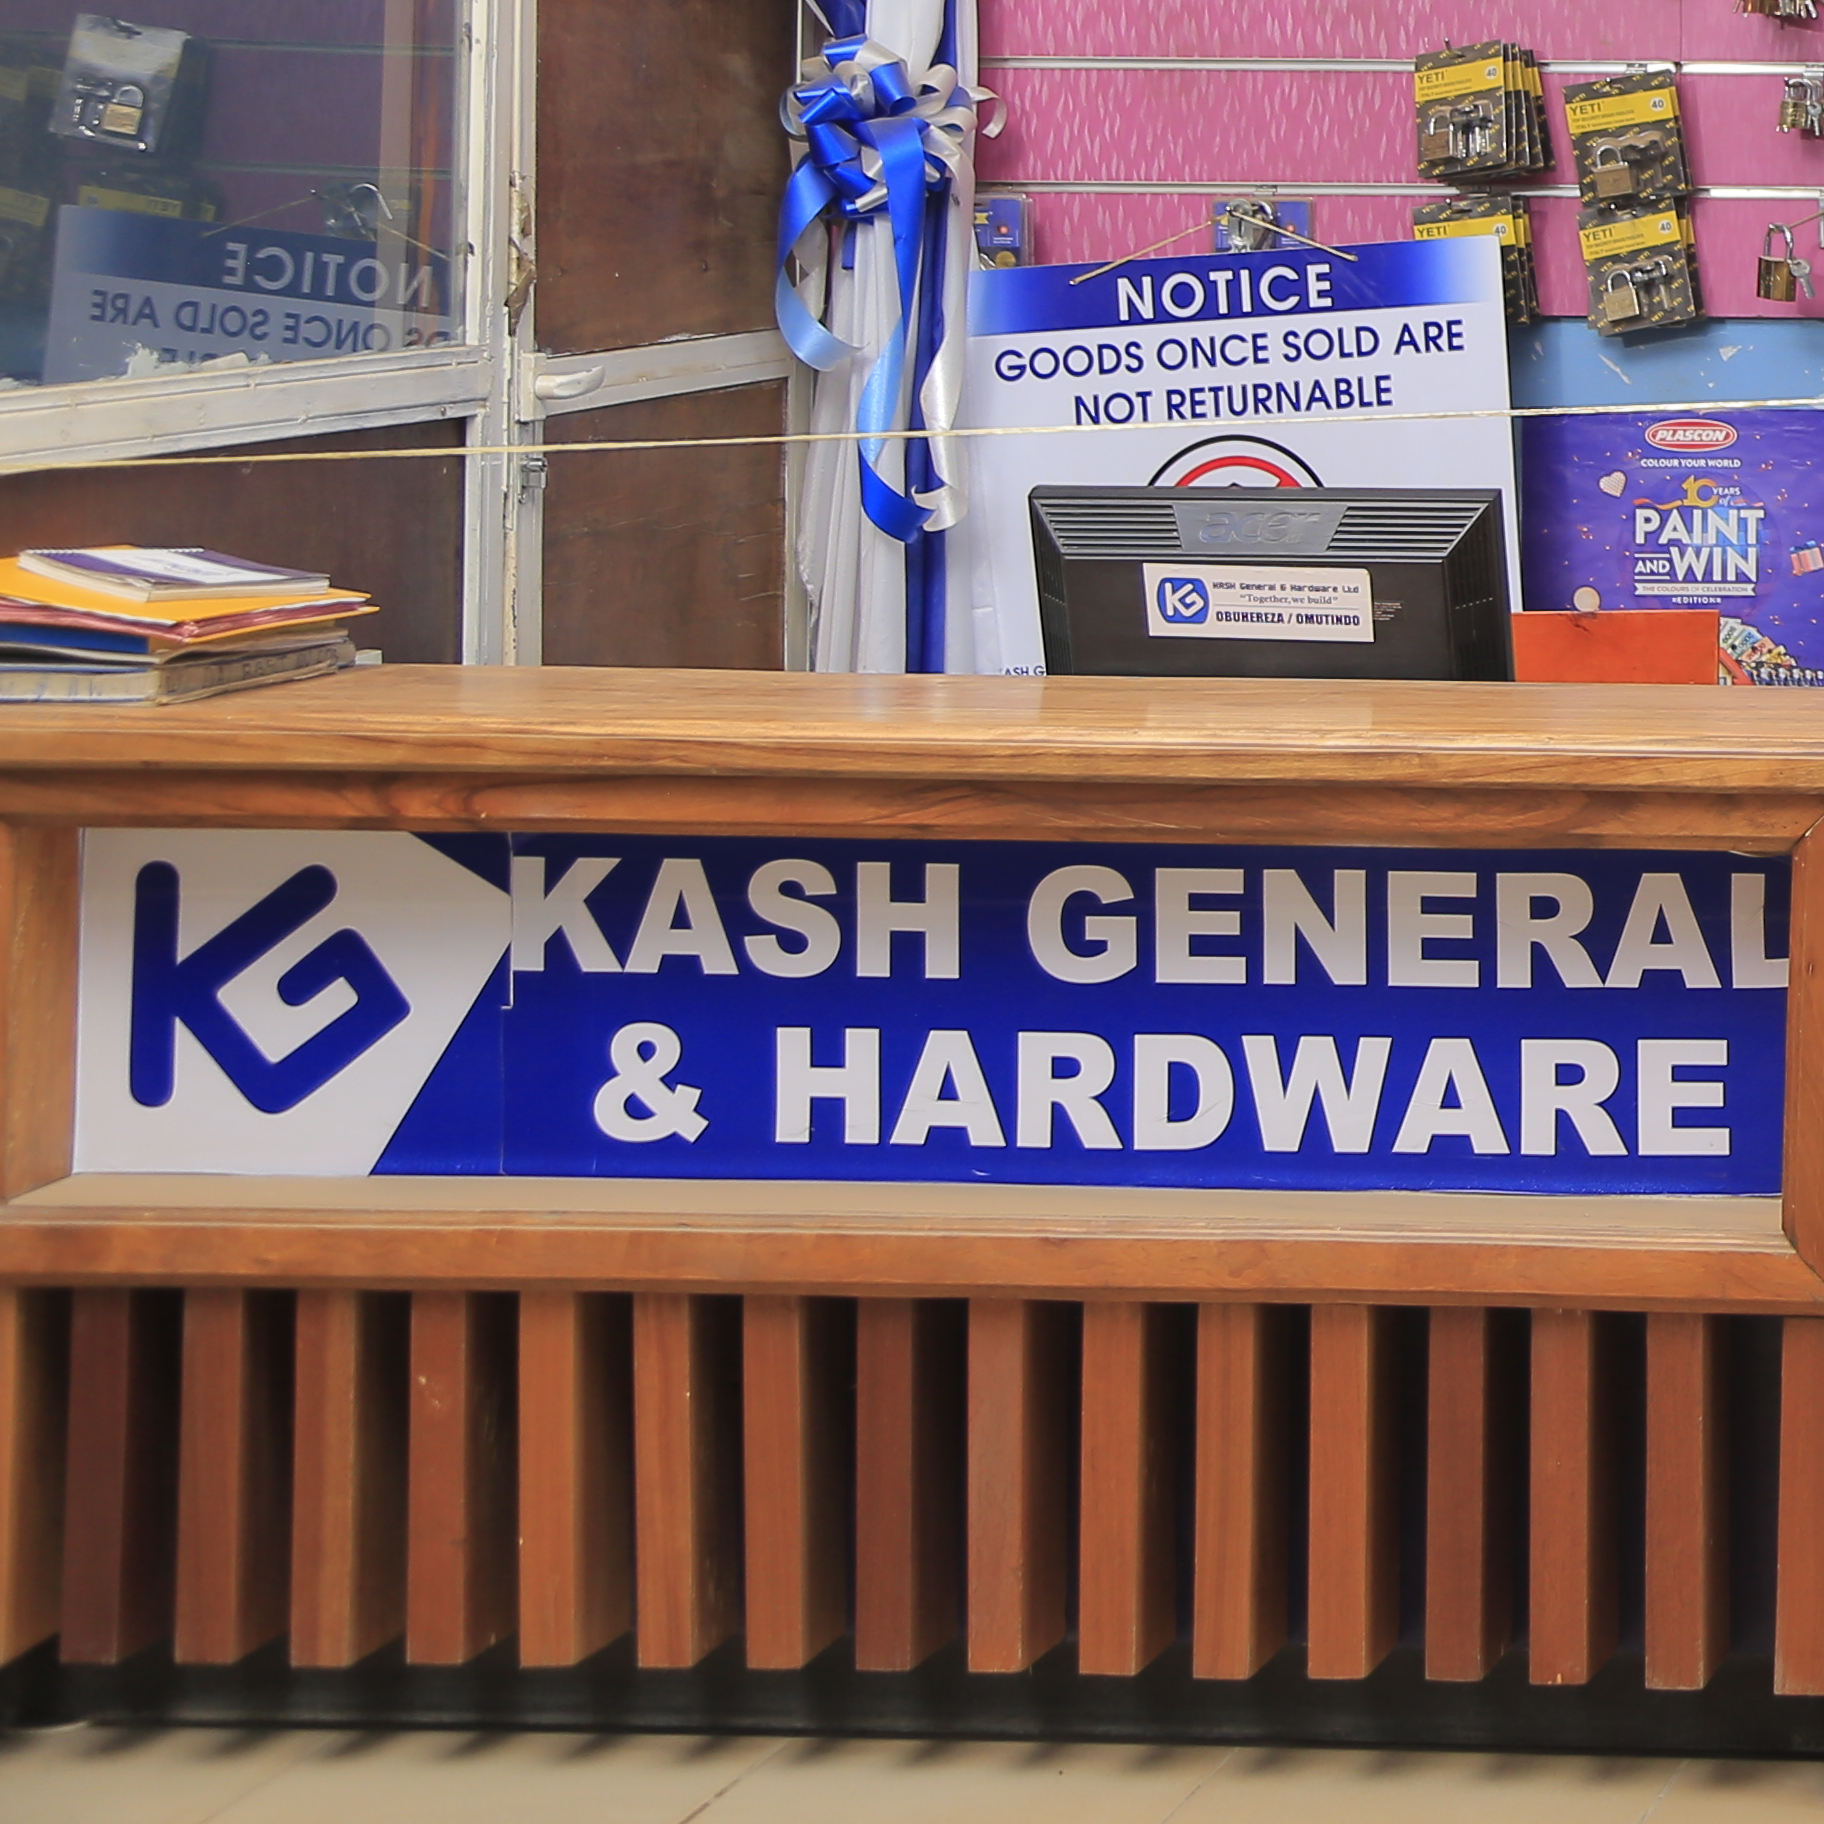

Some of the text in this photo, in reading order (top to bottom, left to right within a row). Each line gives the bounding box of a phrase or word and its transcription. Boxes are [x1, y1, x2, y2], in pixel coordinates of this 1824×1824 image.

[1418, 68, 1497, 84] YETI 40
[1570, 100, 1664, 116] YETI 40
[1417, 226, 1506, 238] YETI 40
[1583, 223, 1671, 242] YETI 40
[1116, 262, 1334, 322] NOTICE
[994, 319, 1466, 383] GOODS ONCE SOLD ARE
[1074, 374, 1394, 426] NOT RETURNABLE
[1654, 430, 1727, 442] PLASCON
[1641, 458, 1741, 468] COLOUR YOUR WORLD
[1712, 487, 1740, 495] YEARS
[1200, 511, 1322, 543] acer
[1635, 508, 1765, 545] PAINT
[1634, 547, 1757, 582] AND WIN
[1240, 582, 1276, 591] General
[1290, 584, 1339, 593] Hardware
[1216, 611, 1284, 624] OBUHEREZA
[1296, 612, 1360, 626] OMUTINDO
[513, 856, 1790, 989] KASH GENERAL
[593, 1021, 1733, 1156] & HARDWARE
